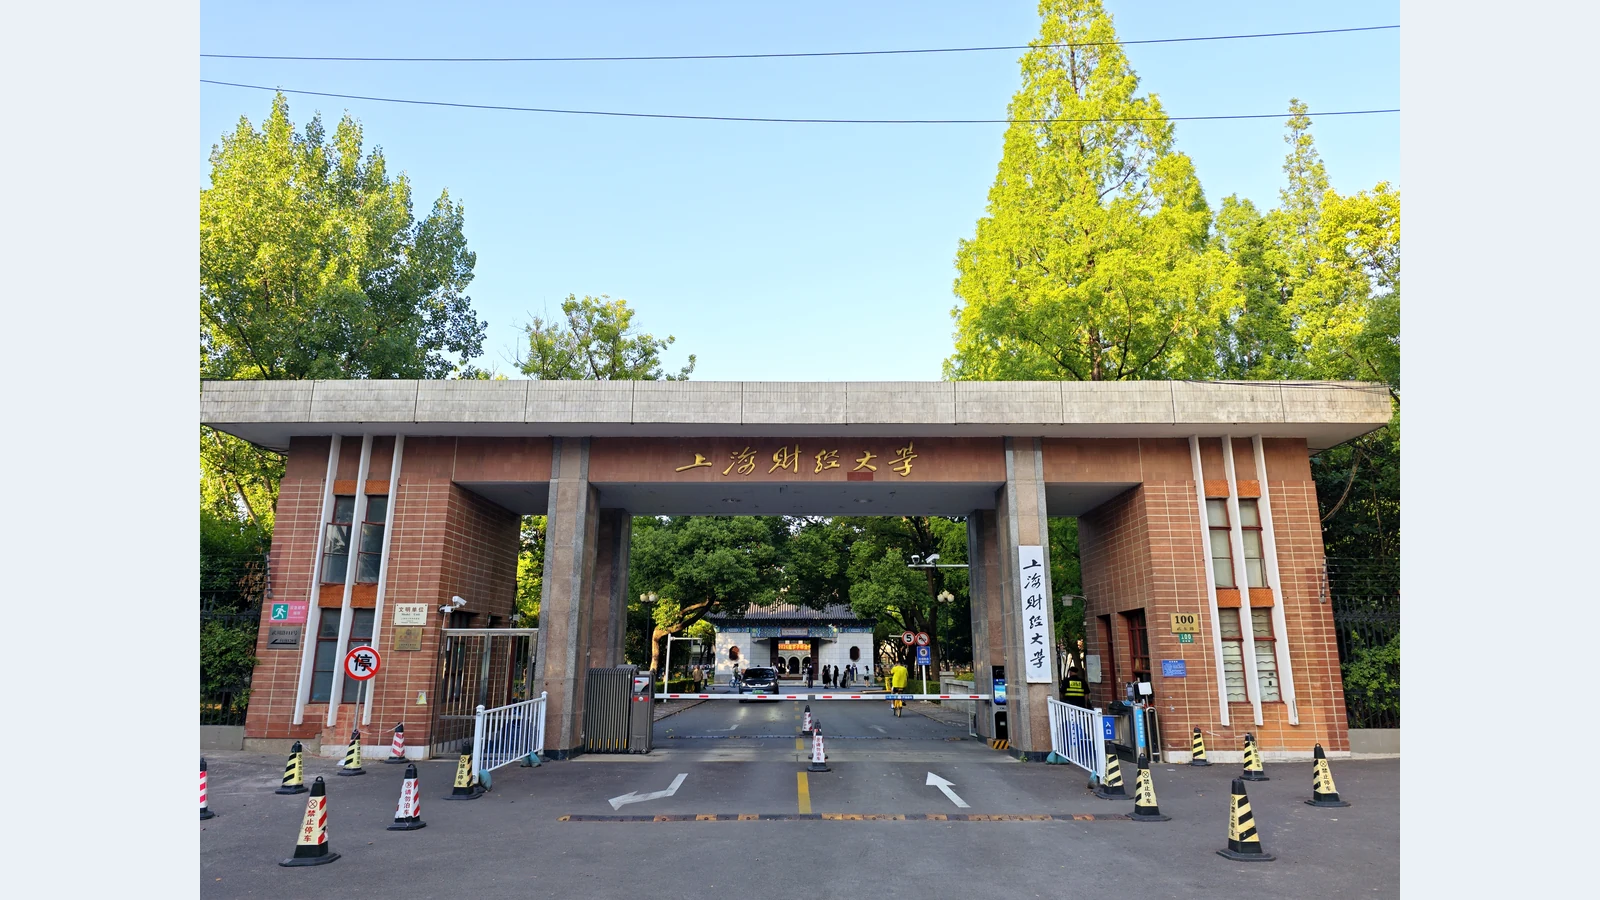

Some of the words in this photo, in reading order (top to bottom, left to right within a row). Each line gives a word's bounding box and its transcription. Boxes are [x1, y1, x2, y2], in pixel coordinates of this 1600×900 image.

[675, 441, 919, 477] 上海财经大学
[1022, 559, 1046, 669] 上海财经大学
[1174, 615, 1194, 624] 100
[906, 634, 912, 642] 5
[353, 653, 373, 672] 停
[1105, 721, 1112, 735] 入口
[458, 764, 466, 786] 禁止停车
[1322, 768, 1331, 791] 禁止停车
[403, 789, 411, 815] 请勿泊车
[1143, 779, 1152, 804] 禁止停车
[304, 810, 316, 842] 禁止停车
